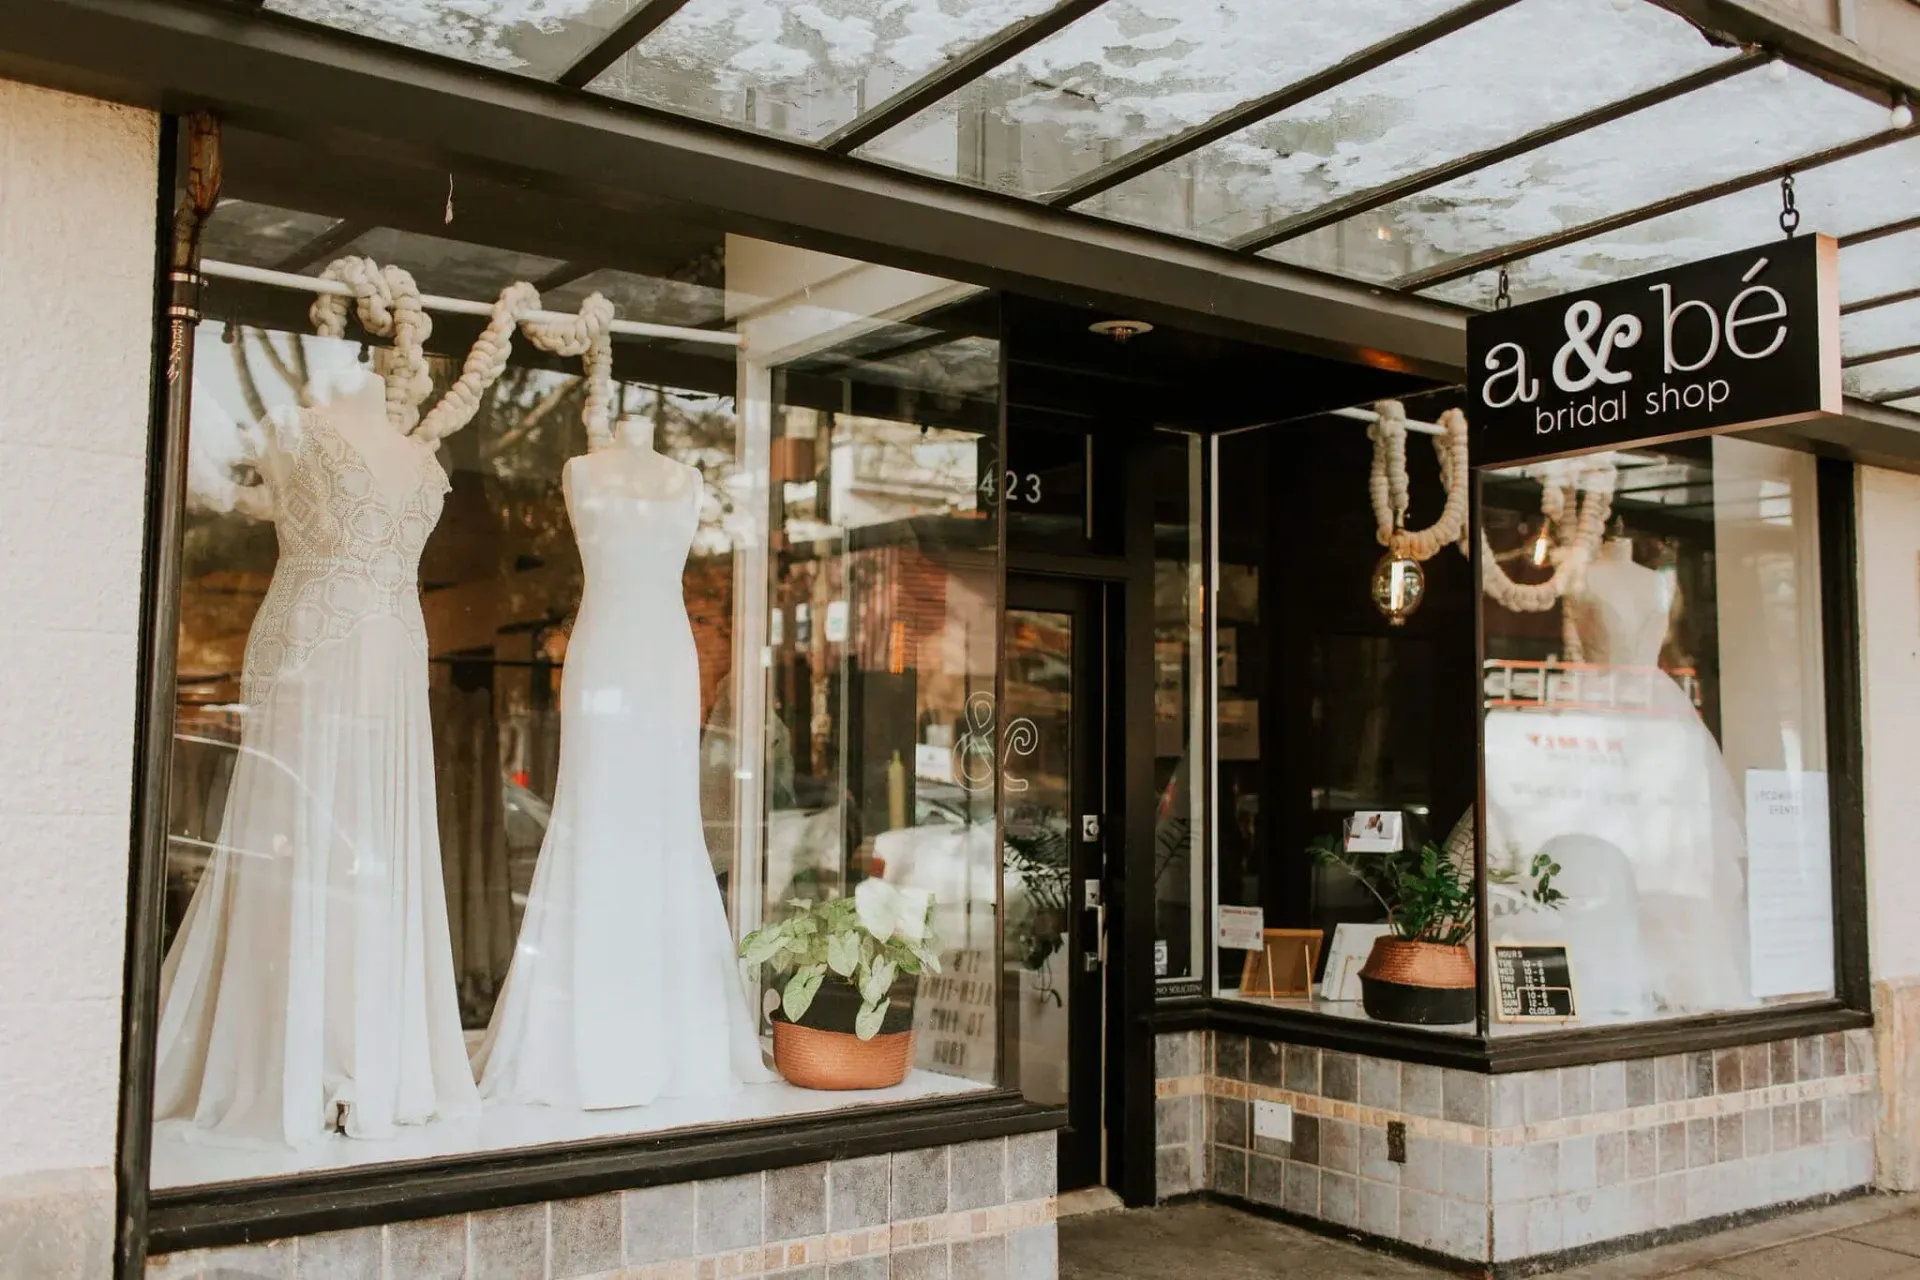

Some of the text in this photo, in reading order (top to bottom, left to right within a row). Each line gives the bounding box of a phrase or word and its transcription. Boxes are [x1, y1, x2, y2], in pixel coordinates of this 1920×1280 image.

[1482, 257, 1788, 408] a & bé
[1535, 379, 1730, 435] bridal shop
[978, 467, 1042, 504] 423
[1497, 950, 1523, 958] HOURS
[1498, 959, 1512, 968] TUE
[1503, 991, 1516, 999] SAT
[1504, 999, 1518, 1007] SUN
[1529, 1007, 1556, 1015] CLOSED
